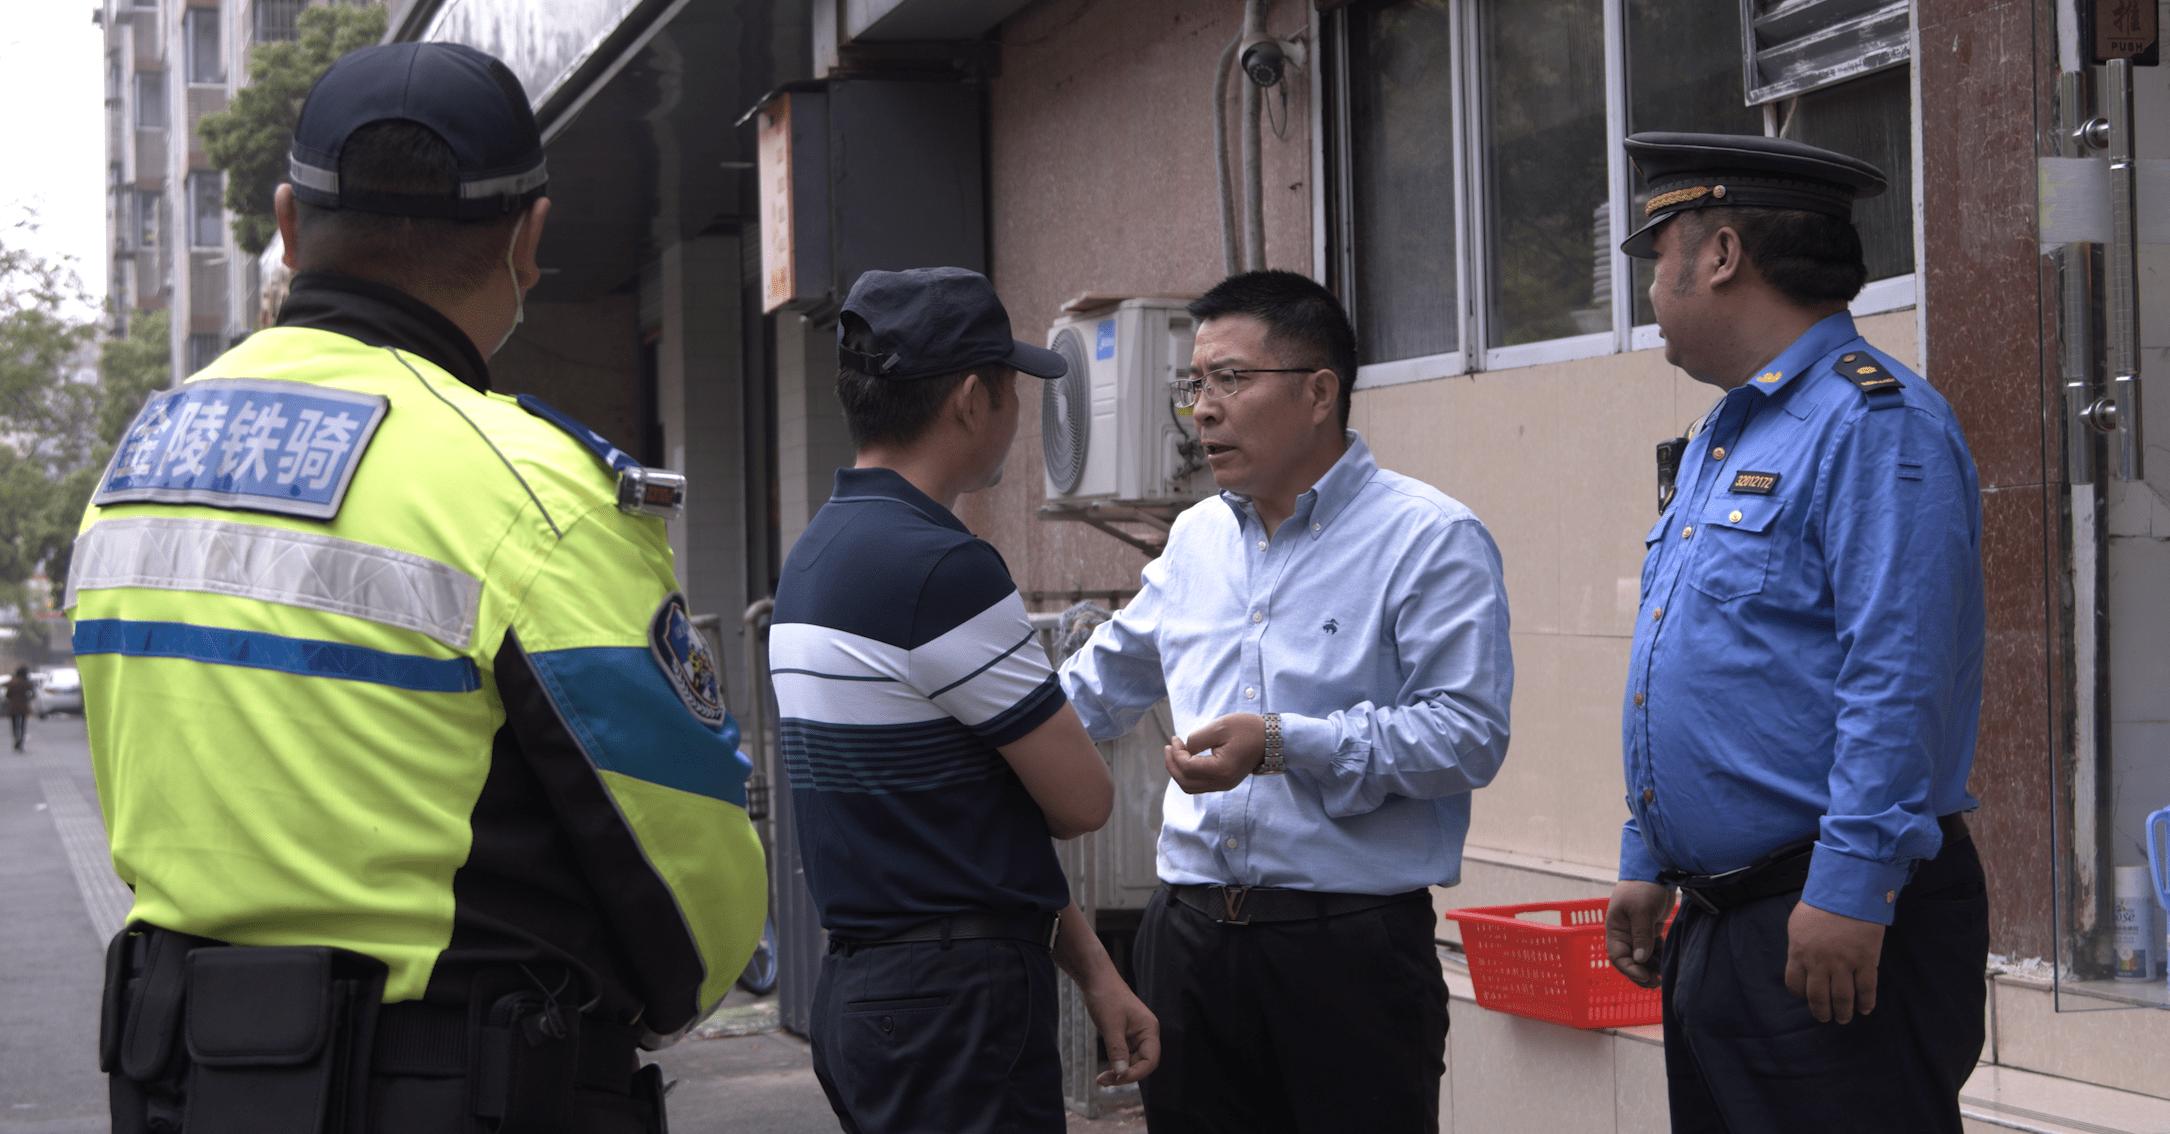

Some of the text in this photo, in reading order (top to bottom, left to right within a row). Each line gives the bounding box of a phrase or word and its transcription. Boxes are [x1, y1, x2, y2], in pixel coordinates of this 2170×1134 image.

[2111, 41, 2143, 52] PUSH
[115, 400, 360, 490] 金陵铁骑
[1735, 474, 1774, 489] 32012172
